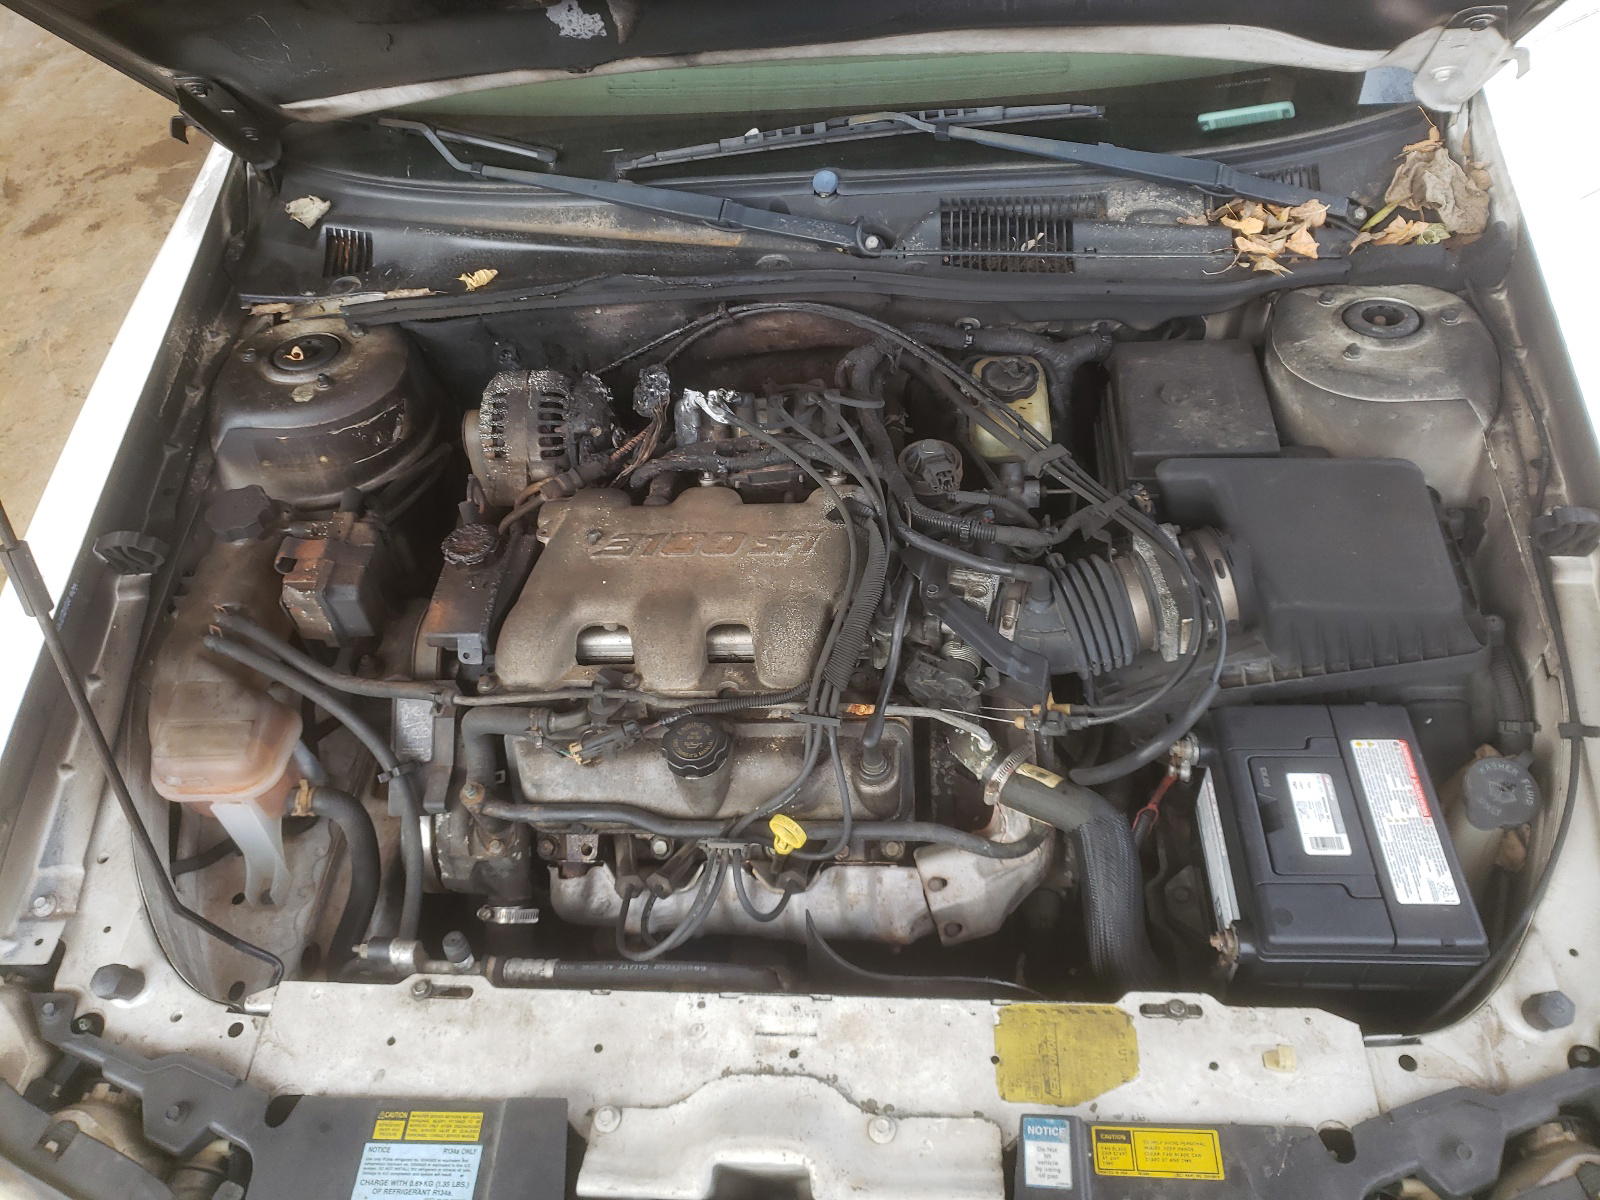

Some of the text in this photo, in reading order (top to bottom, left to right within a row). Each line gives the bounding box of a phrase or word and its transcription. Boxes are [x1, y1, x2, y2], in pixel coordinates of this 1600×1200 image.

[1027, 1125, 1067, 1137] NOTICE
[368, 1146, 391, 1154] NOTICE
[383, 1188, 431, 1196] REFRIGERANT
